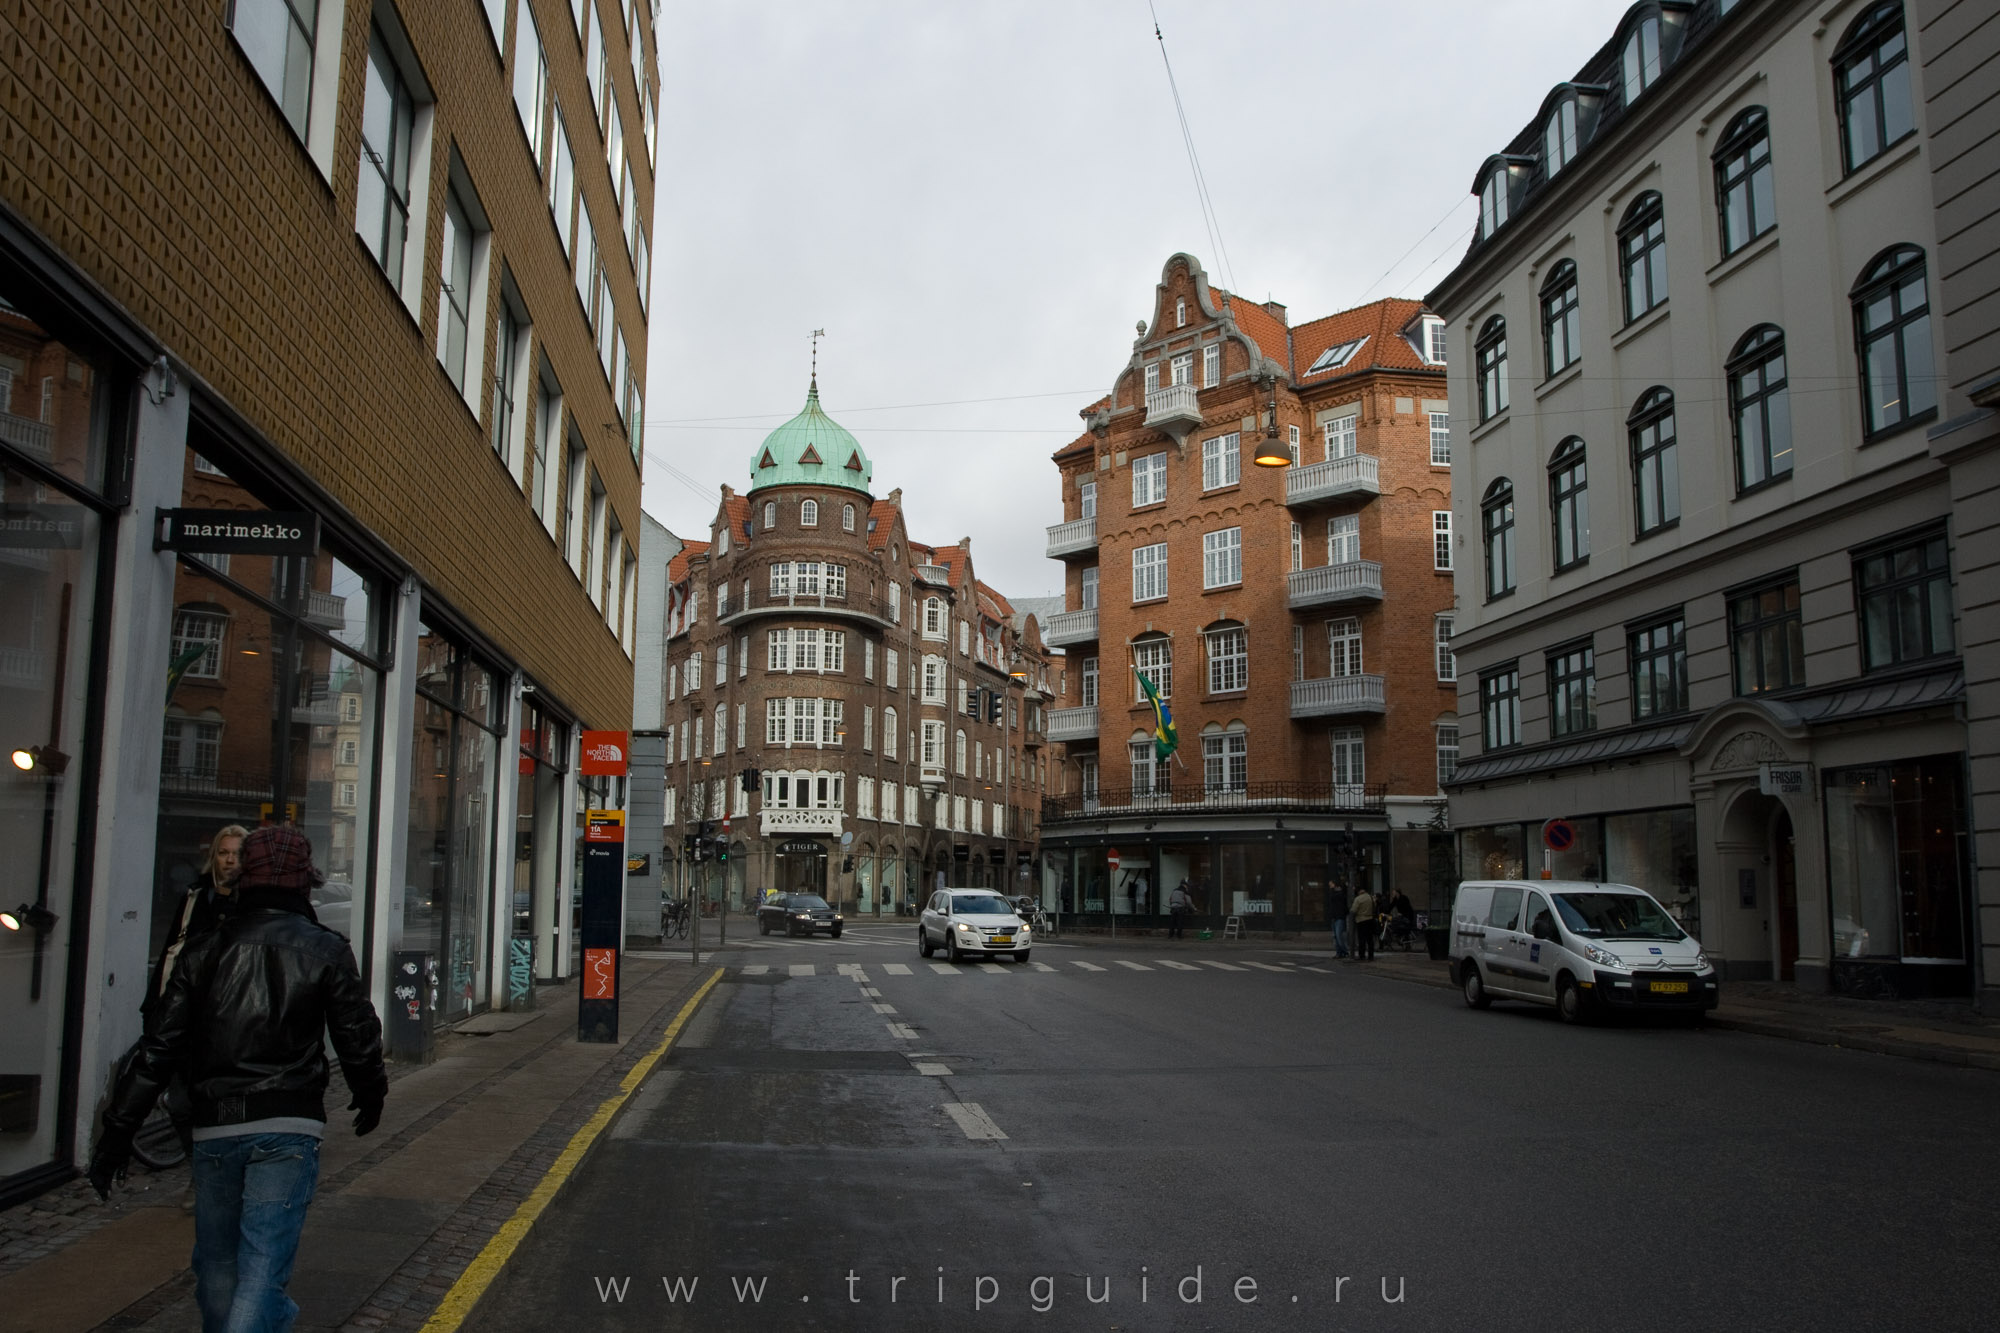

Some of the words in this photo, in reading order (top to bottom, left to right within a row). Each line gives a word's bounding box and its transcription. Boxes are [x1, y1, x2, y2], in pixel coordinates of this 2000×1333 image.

[184, 523, 302, 540] marimekko
[1084, 898, 1105, 912] Storm
[1652, 983, 1662, 991] VT
[1674, 984, 1687, 992] 252
